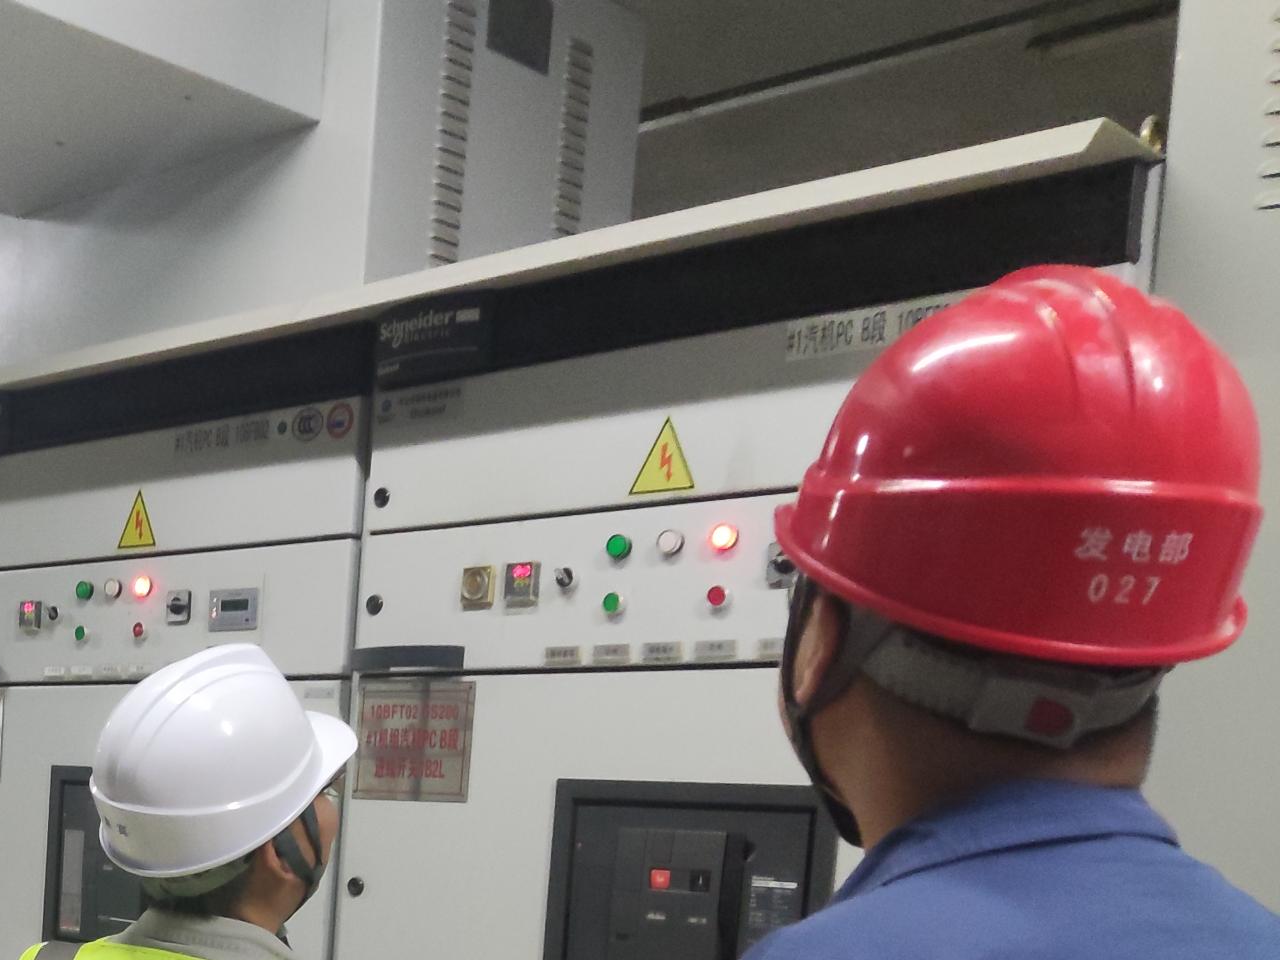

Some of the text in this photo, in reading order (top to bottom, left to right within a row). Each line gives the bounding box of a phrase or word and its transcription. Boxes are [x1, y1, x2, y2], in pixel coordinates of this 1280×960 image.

[1074, 526, 1194, 565] 发电部
[1088, 573, 1161, 605] 027
